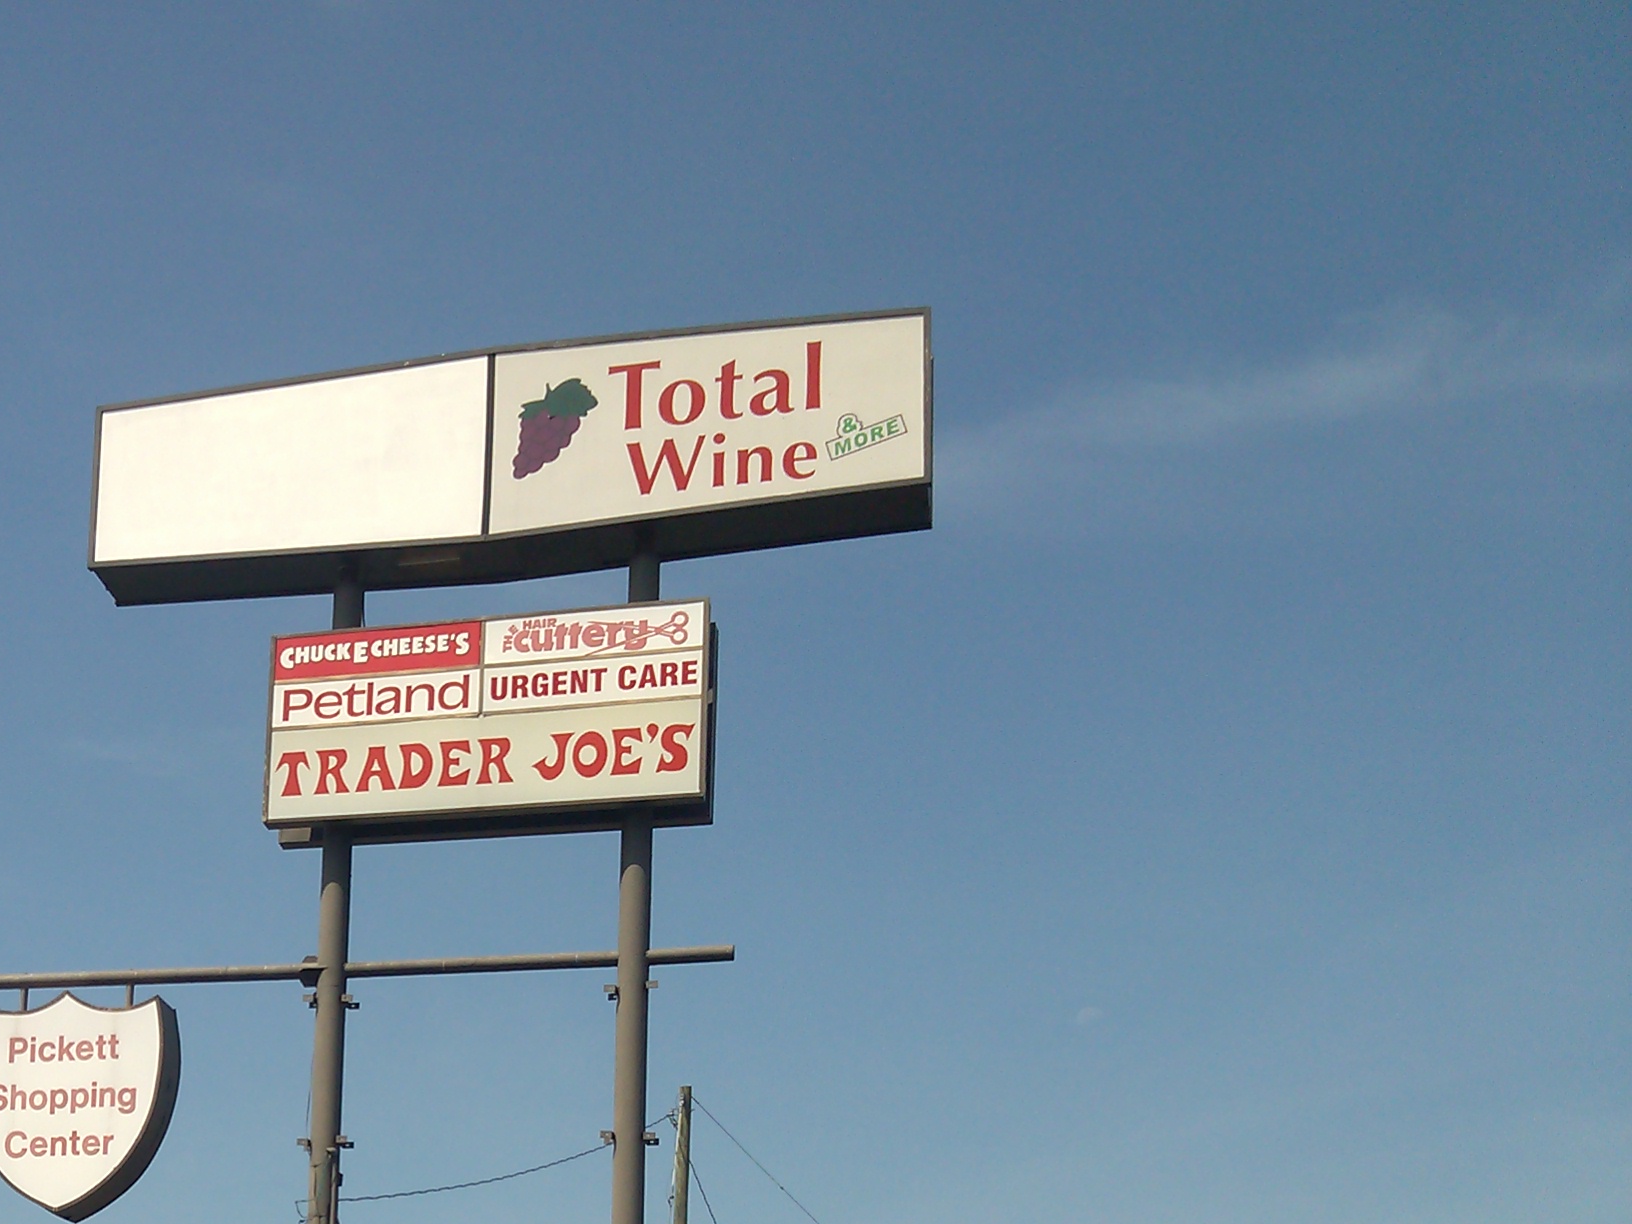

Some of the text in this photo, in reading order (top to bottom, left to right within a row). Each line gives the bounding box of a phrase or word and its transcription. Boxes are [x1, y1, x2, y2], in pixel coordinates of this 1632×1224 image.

[608, 340, 822, 430] Total
[834, 419, 900, 456] MORE
[842, 417, 857, 434] &
[627, 433, 817, 496] Wine
[502, 624, 518, 653] THE
[522, 618, 557, 630] HAIR
[280, 632, 470, 669] CHUCK E CHEESE'S
[282, 674, 470, 722] Petland
[490, 660, 698, 701] URGENT CARE
[275, 723, 696, 797] TRADER JOE'S
[8, 1034, 120, 1064] Pickett
[4, 1131, 115, 1159] Center
